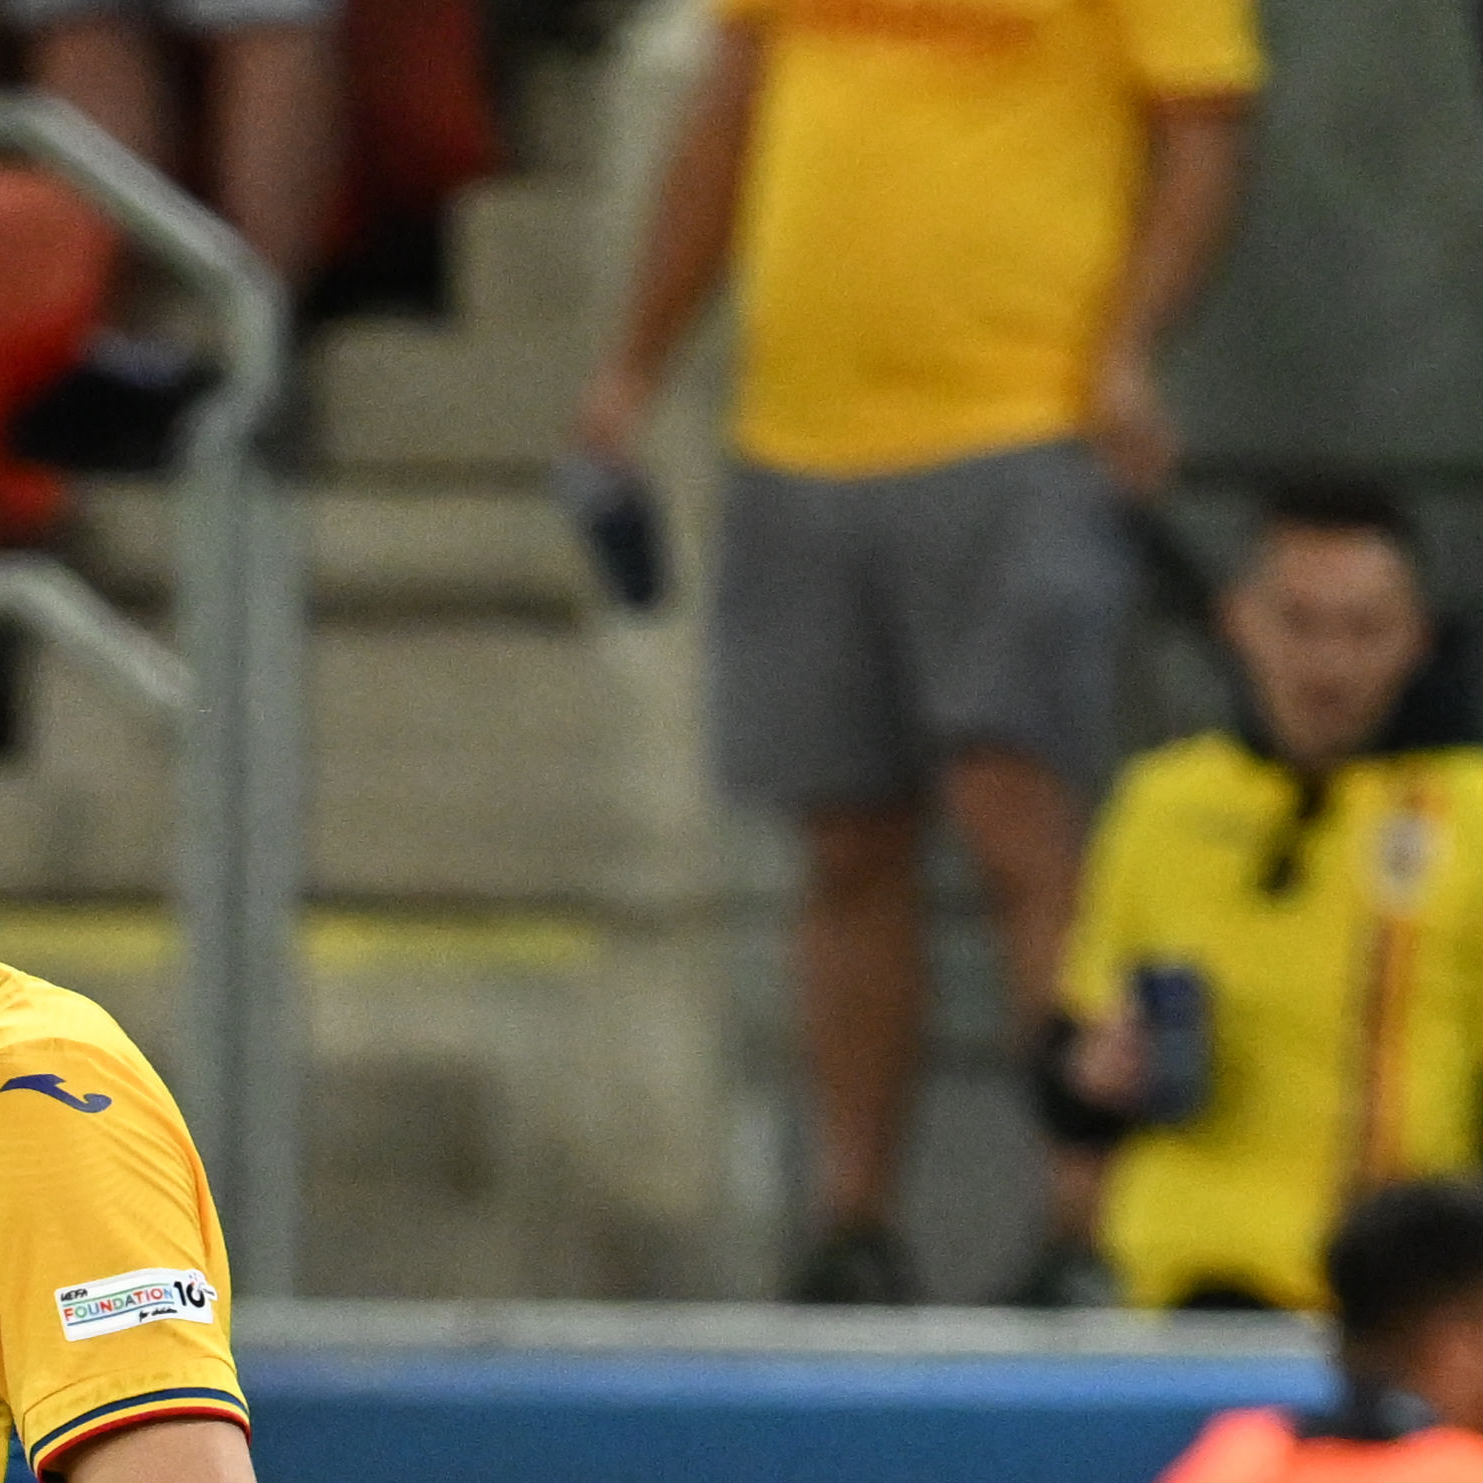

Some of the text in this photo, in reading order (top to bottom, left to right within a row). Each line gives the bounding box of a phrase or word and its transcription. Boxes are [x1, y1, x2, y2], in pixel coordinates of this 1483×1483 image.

[60, 1288, 88, 1302] UEFA
[63, 1287, 174, 1321] FOUNDATION
[173, 1280, 206, 1308] 10
